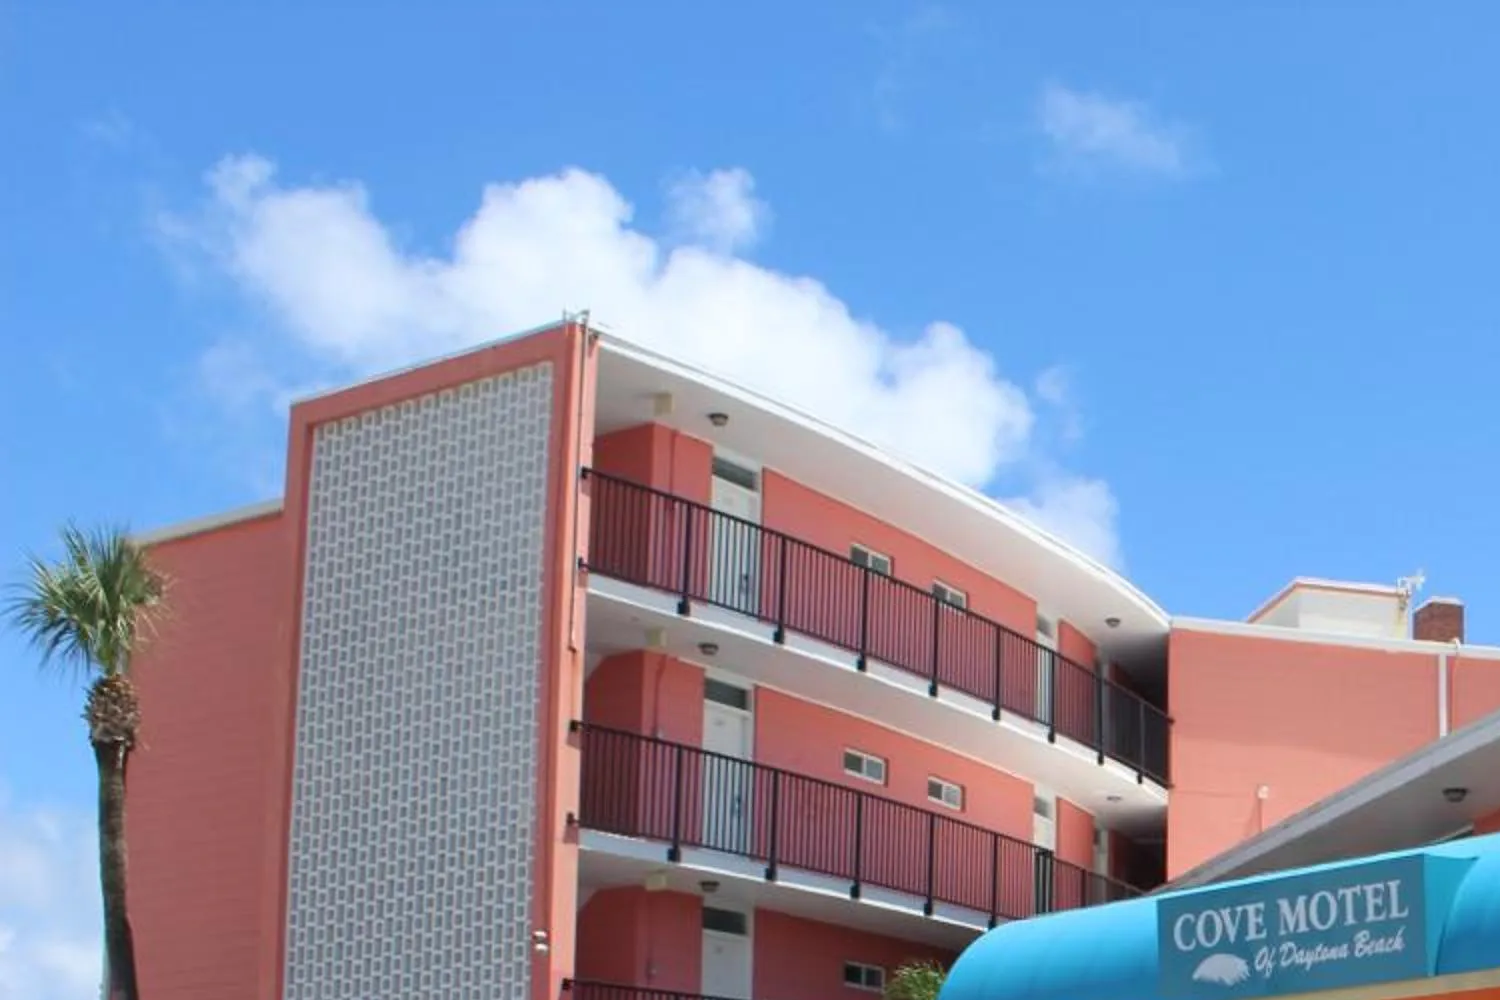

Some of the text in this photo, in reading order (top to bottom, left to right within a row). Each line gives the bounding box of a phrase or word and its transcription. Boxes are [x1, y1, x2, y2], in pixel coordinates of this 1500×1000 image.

[1173, 879, 1409, 951] COVE MOTEL
[1254, 926, 1405, 979] Of Daytona Beach
